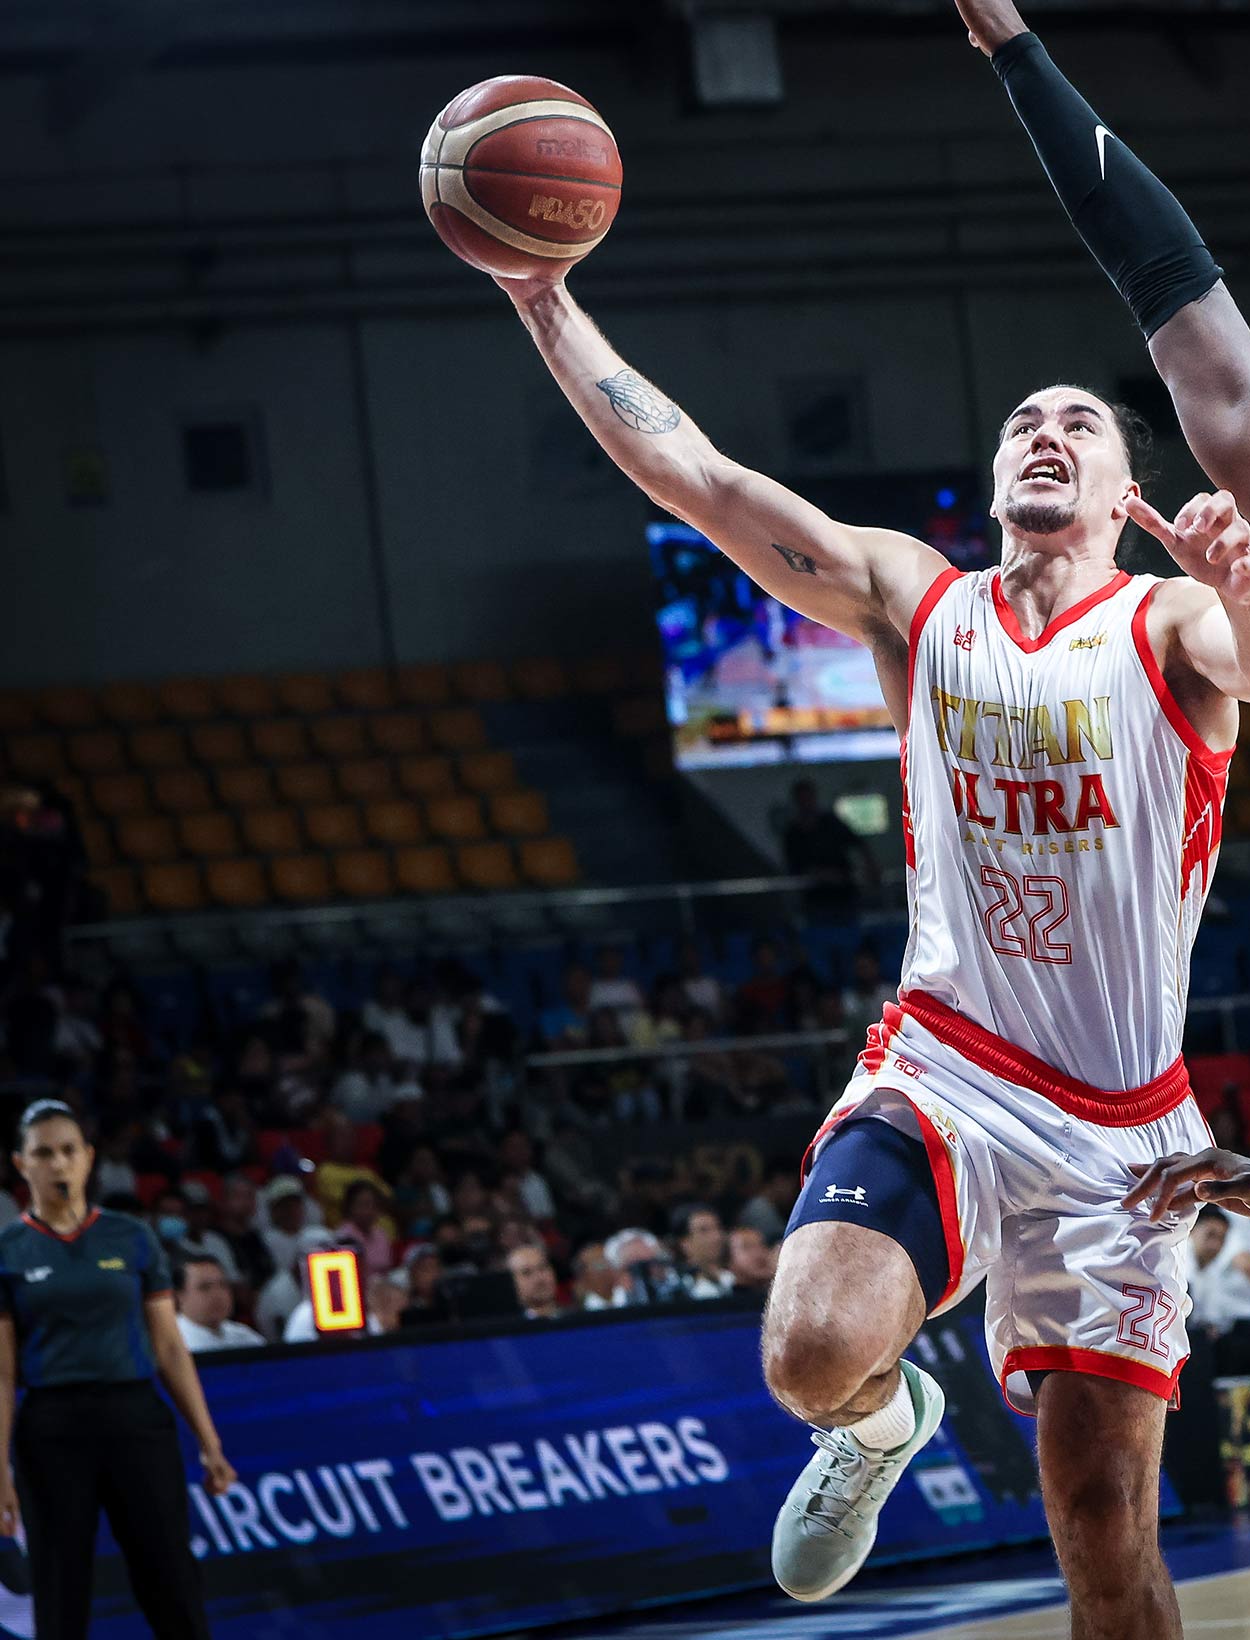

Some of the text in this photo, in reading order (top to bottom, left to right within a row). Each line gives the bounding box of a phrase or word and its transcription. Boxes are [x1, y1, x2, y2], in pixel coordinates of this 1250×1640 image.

[932, 685, 1114, 770] TITAN
[1022, 837, 1104, 856] RISERS
[981, 864, 1073, 965] 22
[308, 1250, 365, 1331] 0
[1116, 1283, 1178, 1358] 22
[190, 1416, 729, 1559] IRCUIT BREAKERS
